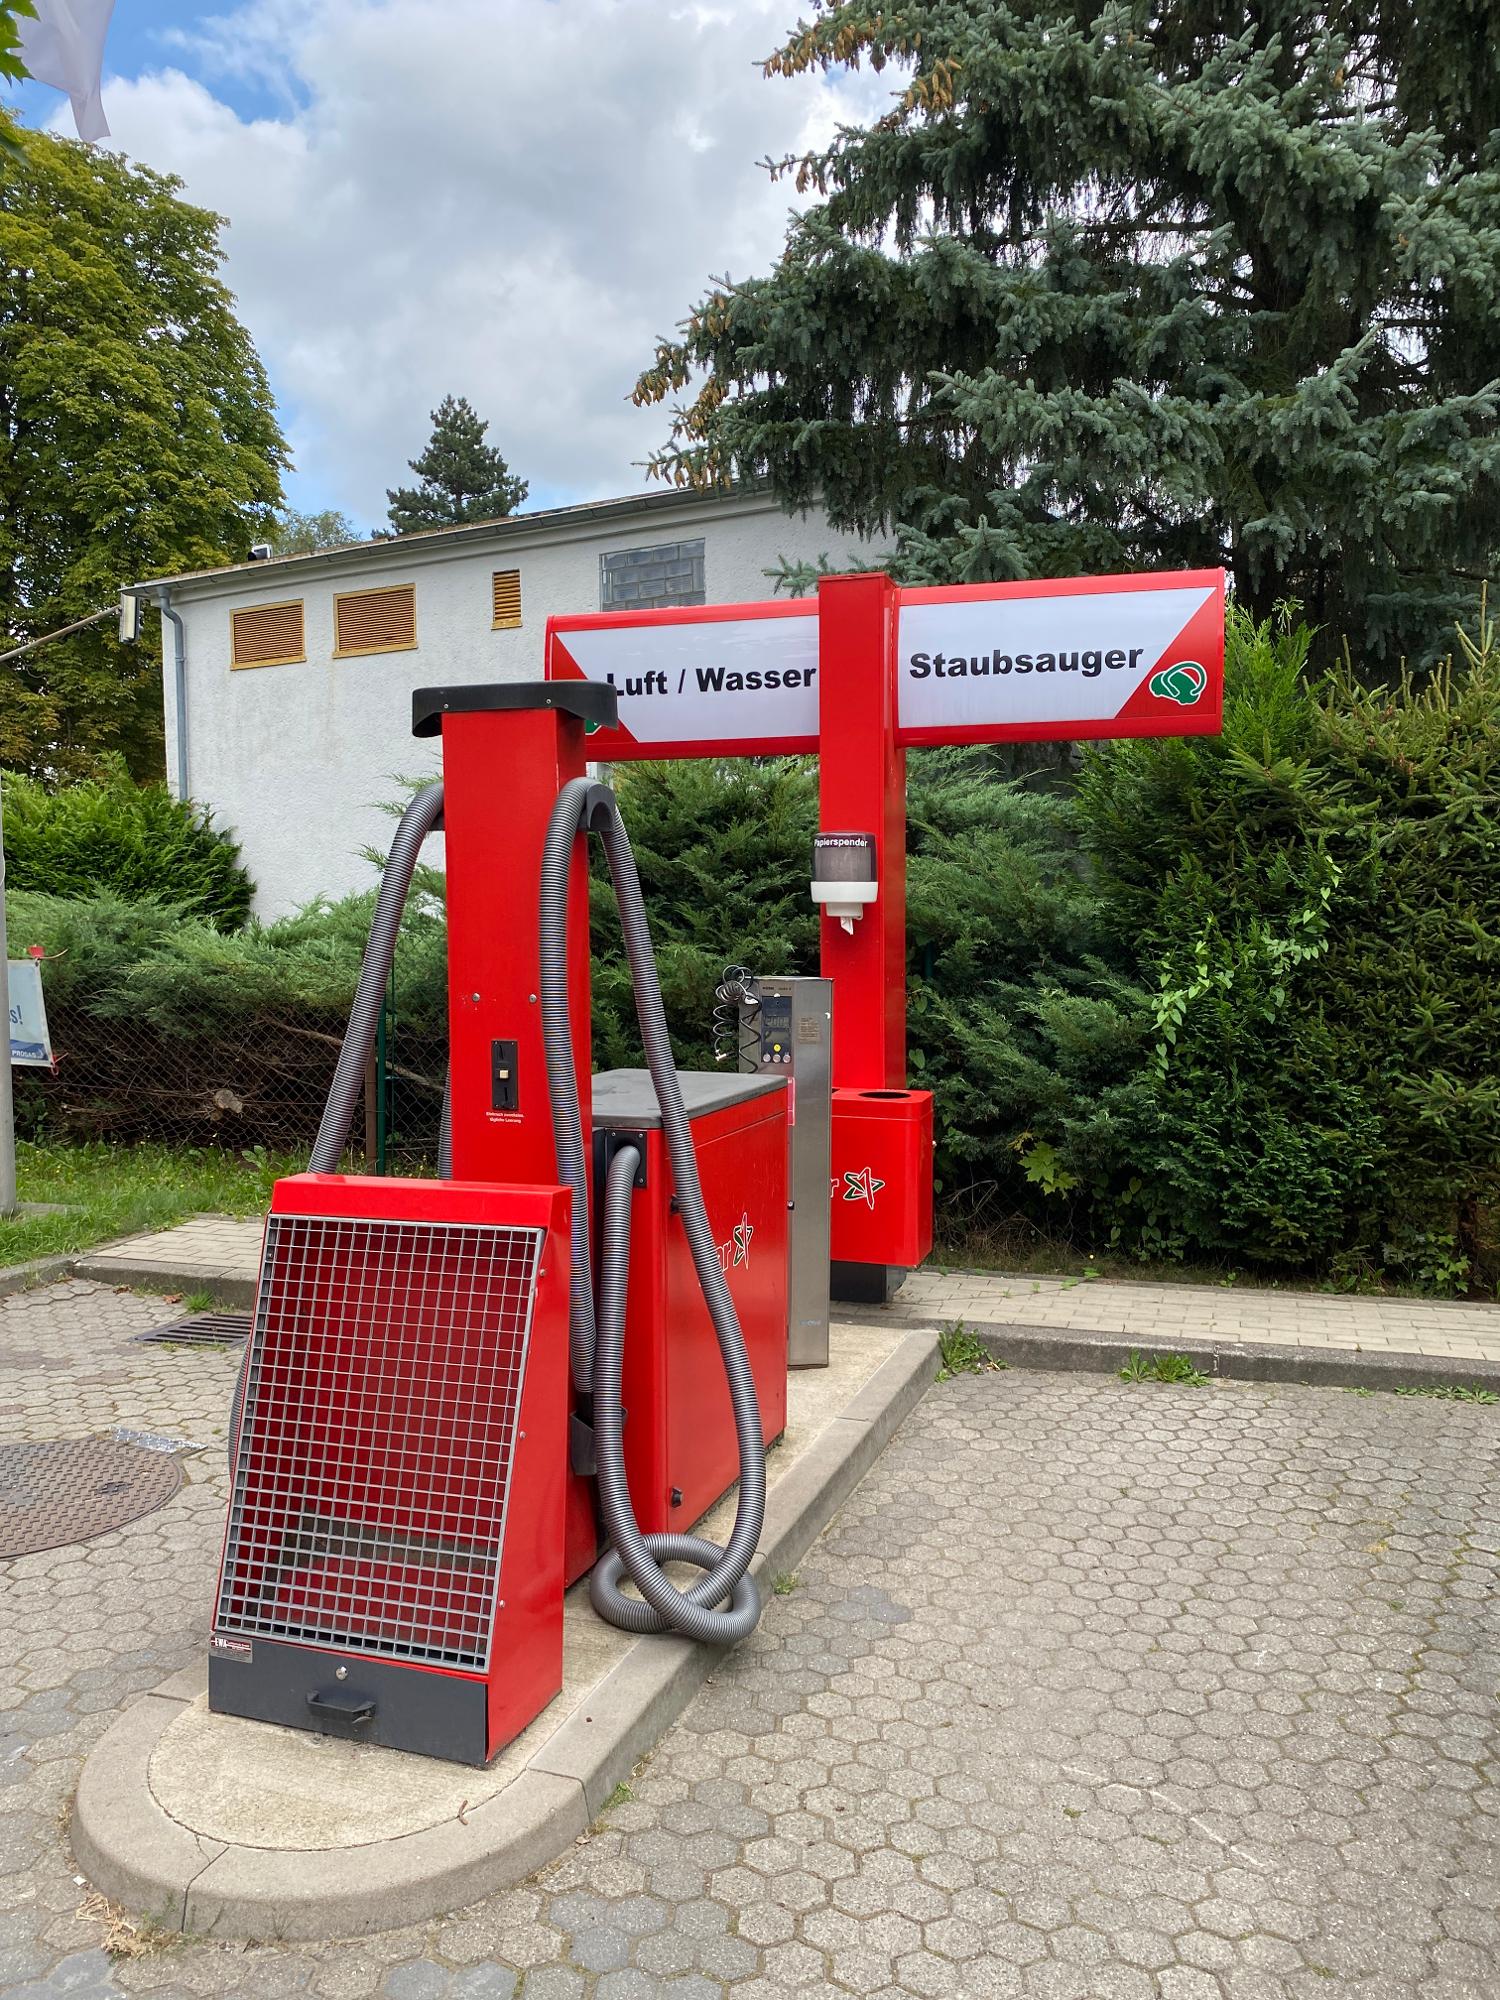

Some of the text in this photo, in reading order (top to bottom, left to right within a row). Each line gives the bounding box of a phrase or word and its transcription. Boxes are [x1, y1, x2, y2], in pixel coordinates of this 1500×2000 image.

[909, 648, 1144, 679] Staubsauger
[677, 668, 686, 694] /
[695, 666, 817, 692] Wasser
